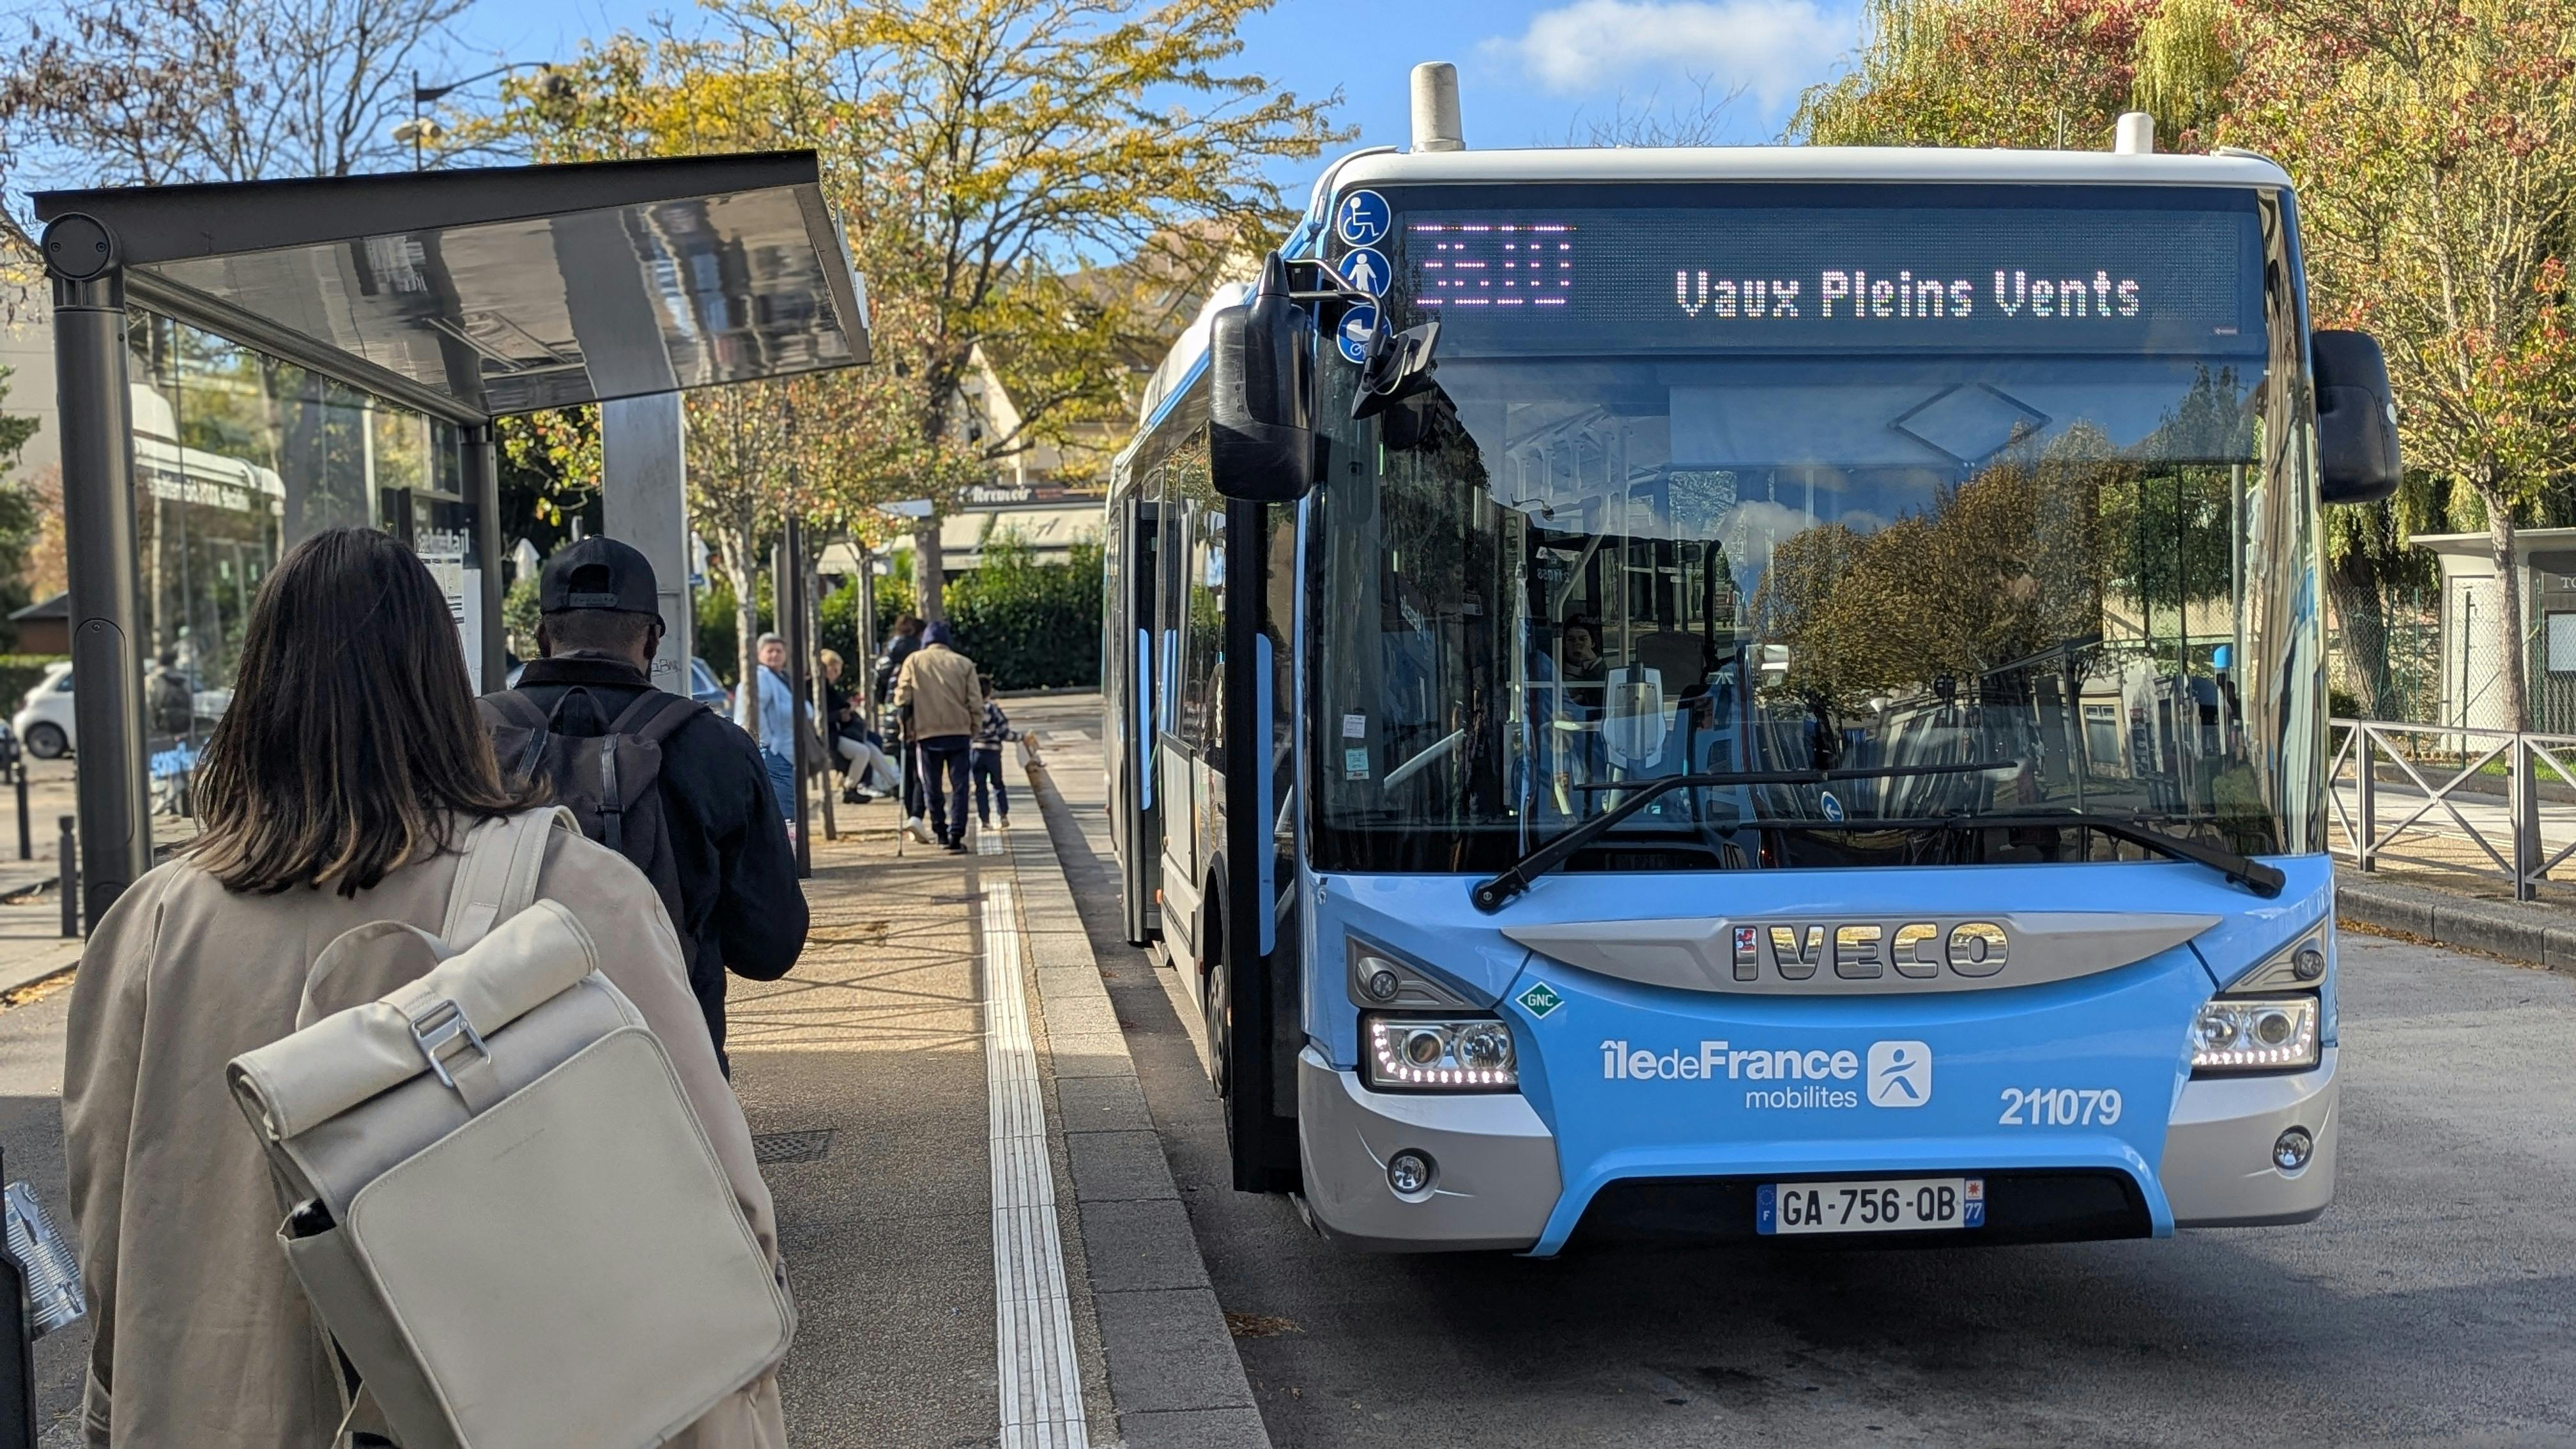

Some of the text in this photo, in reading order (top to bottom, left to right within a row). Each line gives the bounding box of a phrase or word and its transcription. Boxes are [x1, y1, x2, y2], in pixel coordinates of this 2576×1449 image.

[1676, 270, 2140, 318] Vaux Pleins Vents
[1732, 921, 2009, 981] IVECO
[1527, 993, 1554, 1008] GNC
[1999, 1088, 2121, 1126] 211079
[1763, 1186, 1982, 1225] F GA-756-QB 77
